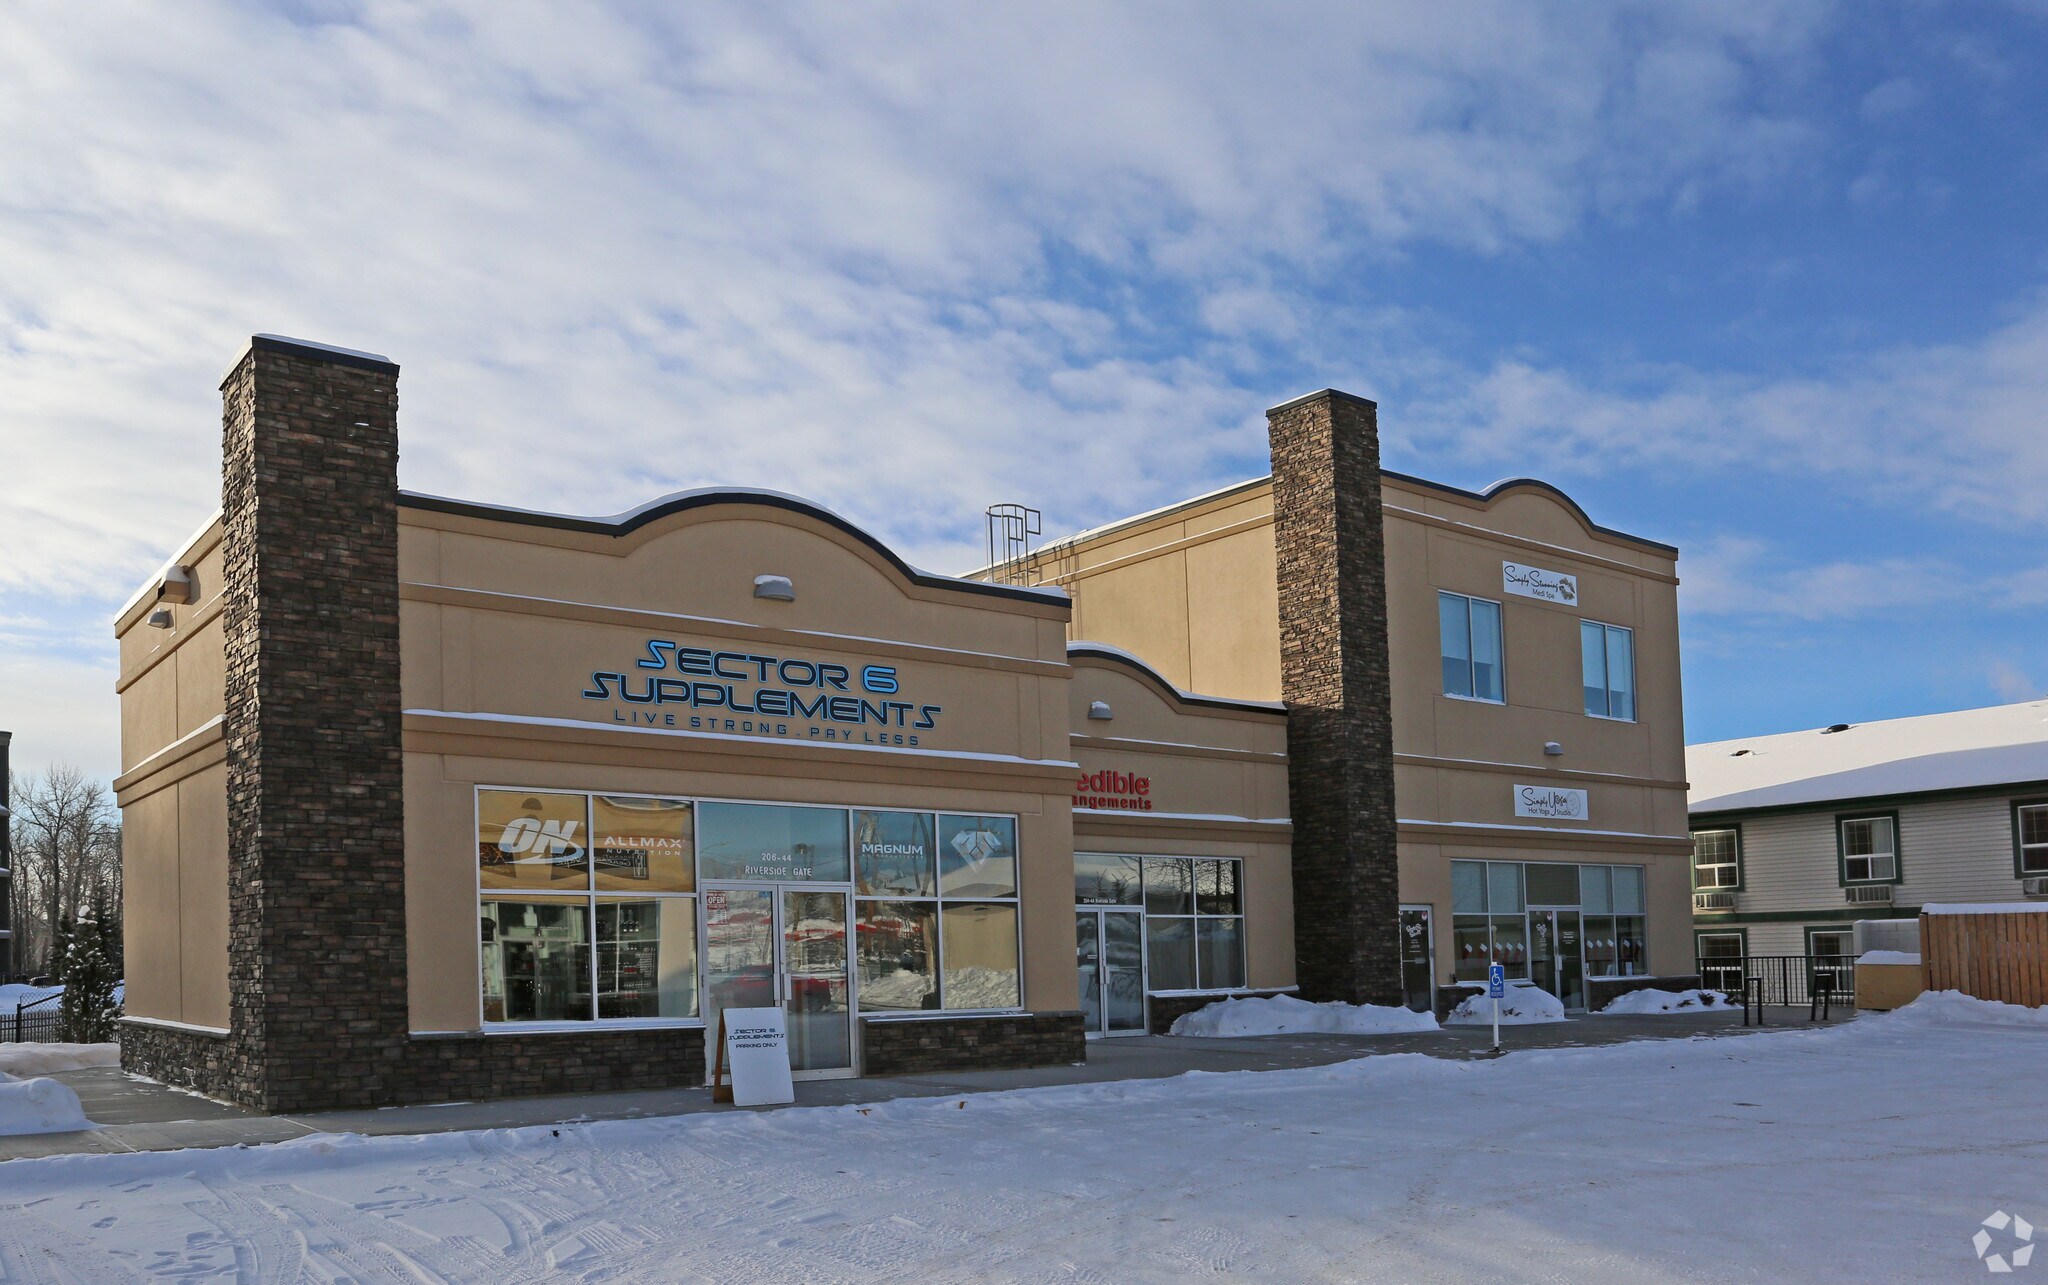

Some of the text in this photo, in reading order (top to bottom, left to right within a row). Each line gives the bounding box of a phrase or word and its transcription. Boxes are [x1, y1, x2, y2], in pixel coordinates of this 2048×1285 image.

[1504, 565, 1559, 592] Simply Stunning
[1546, 591, 1555, 600] Spa
[636, 639, 900, 695] SECTOR 6
[582, 671, 943, 731] SUPPLEMENTS
[615, 709, 675, 726] LIVE
[810, 727, 852, 740] PAY
[865, 731, 919, 746] LESS
[1076, 769, 1150, 796] edible
[1522, 787, 1568, 817] Simply Yoga
[1539, 808, 1550, 817] Yoga
[1556, 808, 1572, 816] Studio
[498, 817, 580, 854] ON
[604, 835, 683, 849] ALLMAX
[606, 847, 682, 857] NUTRITION
[862, 843, 923, 855] MAGNUM
[761, 852, 792, 862] 206-44
[744, 865, 812, 877] RIVERSIDE GATE
[707, 896, 725, 904] OPEN
[728, 1033, 785, 1041] SUPPLEMENTS
